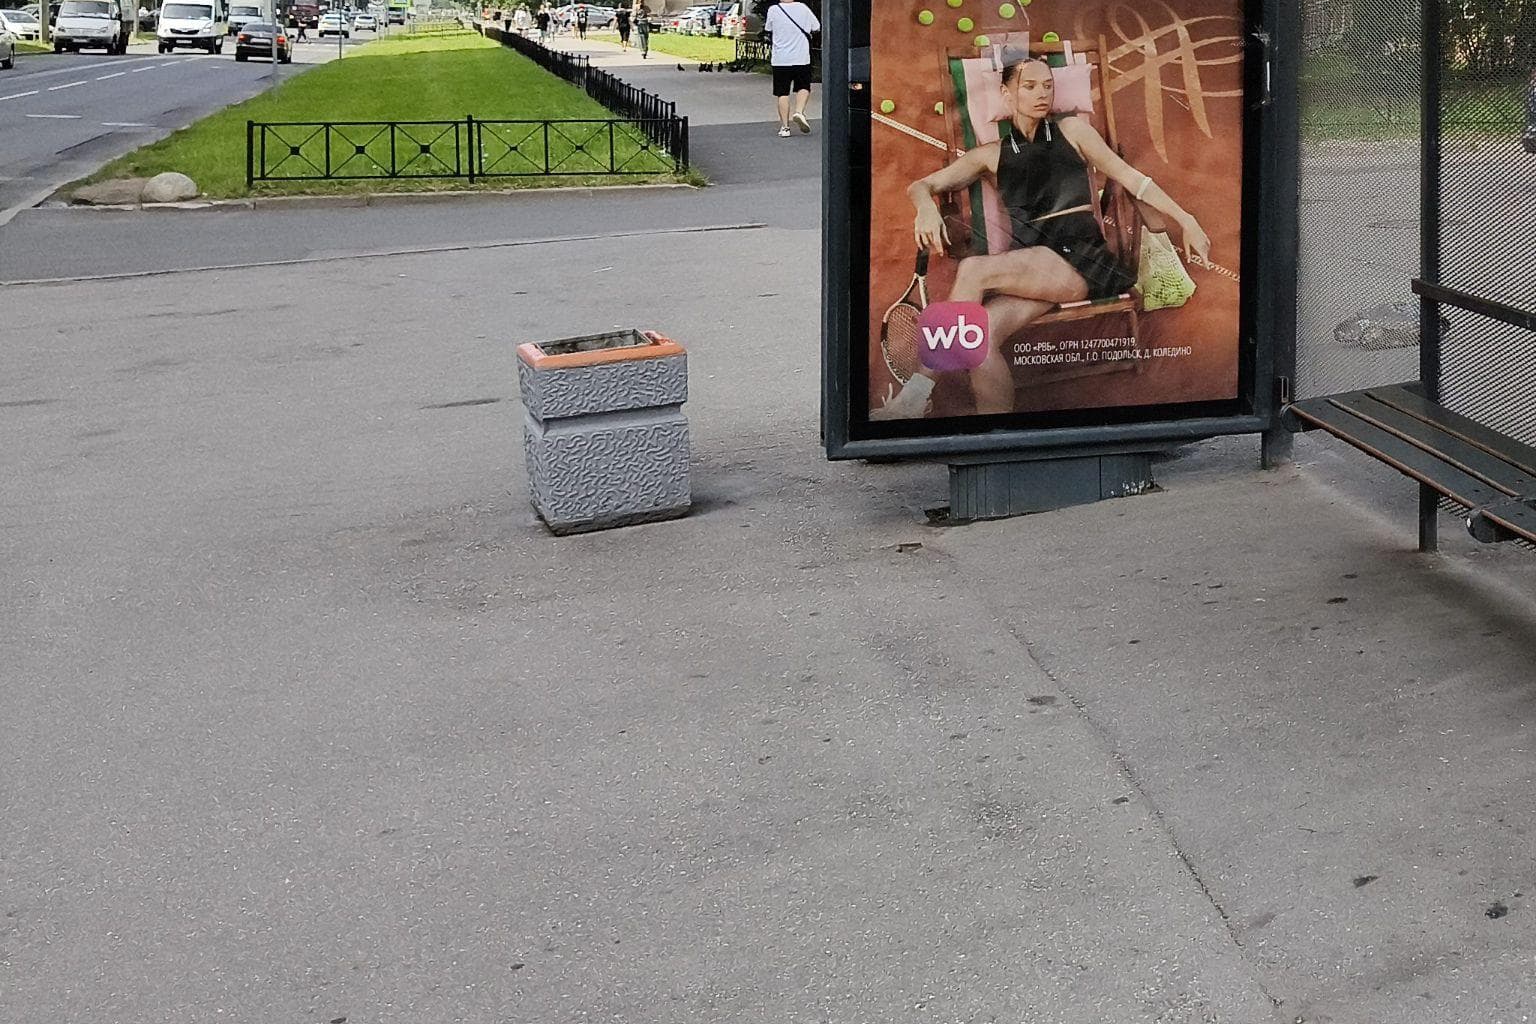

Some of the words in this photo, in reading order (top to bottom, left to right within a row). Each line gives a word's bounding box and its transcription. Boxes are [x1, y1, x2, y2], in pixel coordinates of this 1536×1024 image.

[922, 314, 984, 350] wb
[1014, 342, 1031, 353] ООО
[1060, 340, 1079, 350] ОГРН
[1014, 353, 1064, 366] МОСКОВСКАЯ
[1153, 345, 1192, 358] КОЛЕДИНО
